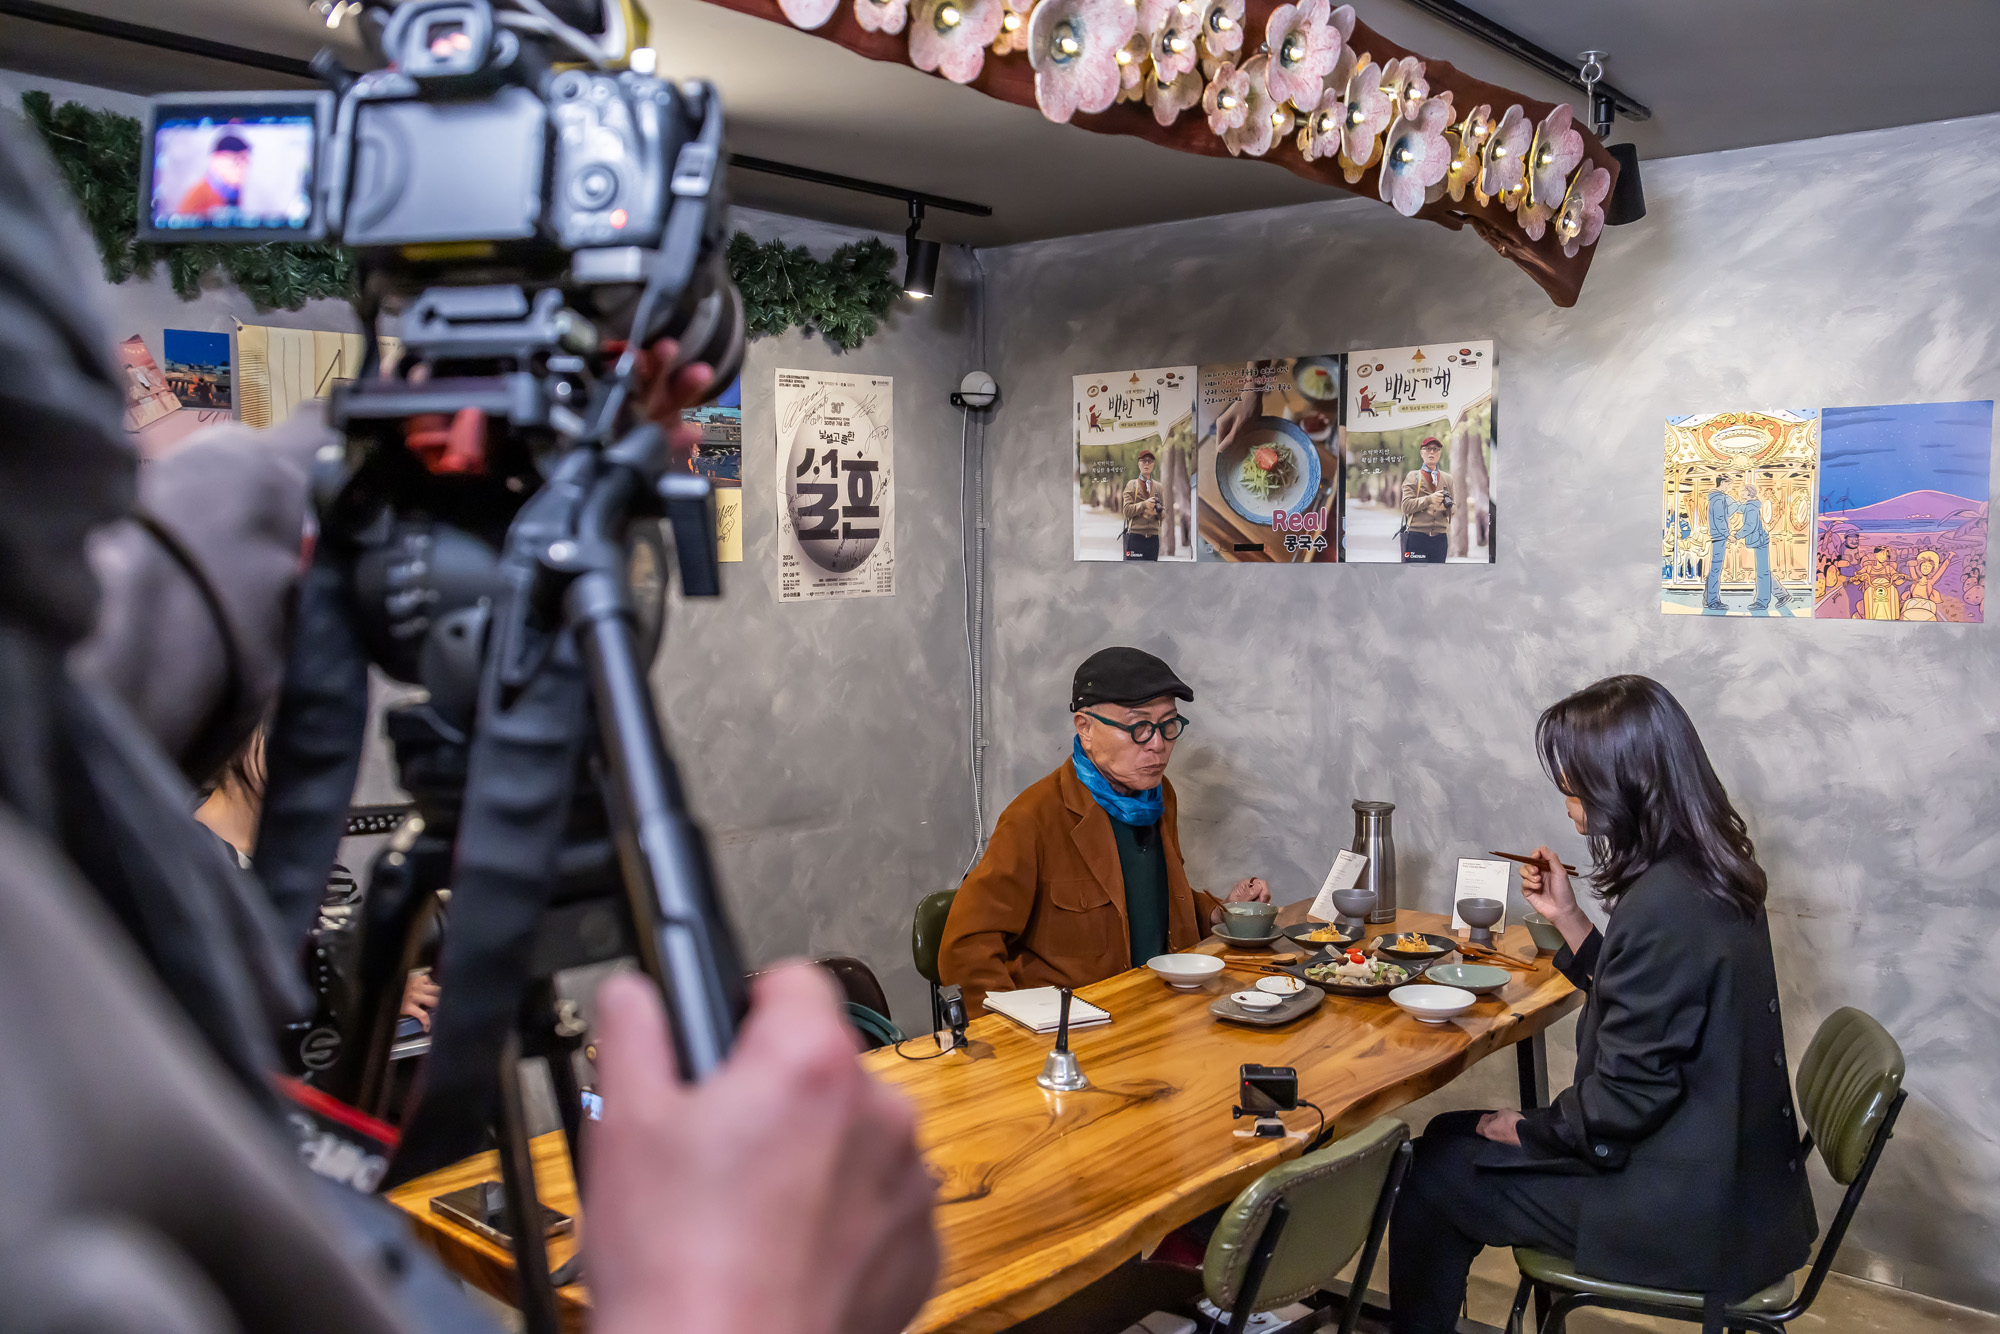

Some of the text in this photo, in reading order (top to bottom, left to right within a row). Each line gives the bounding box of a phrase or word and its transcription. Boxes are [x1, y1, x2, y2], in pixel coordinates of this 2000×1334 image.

[1386, 366, 1450, 403] 백반기행
[1109, 388, 1159, 420] 백반기행
[1272, 507, 1327, 532] Real
[1284, 535, 1328, 552] 콩국수
